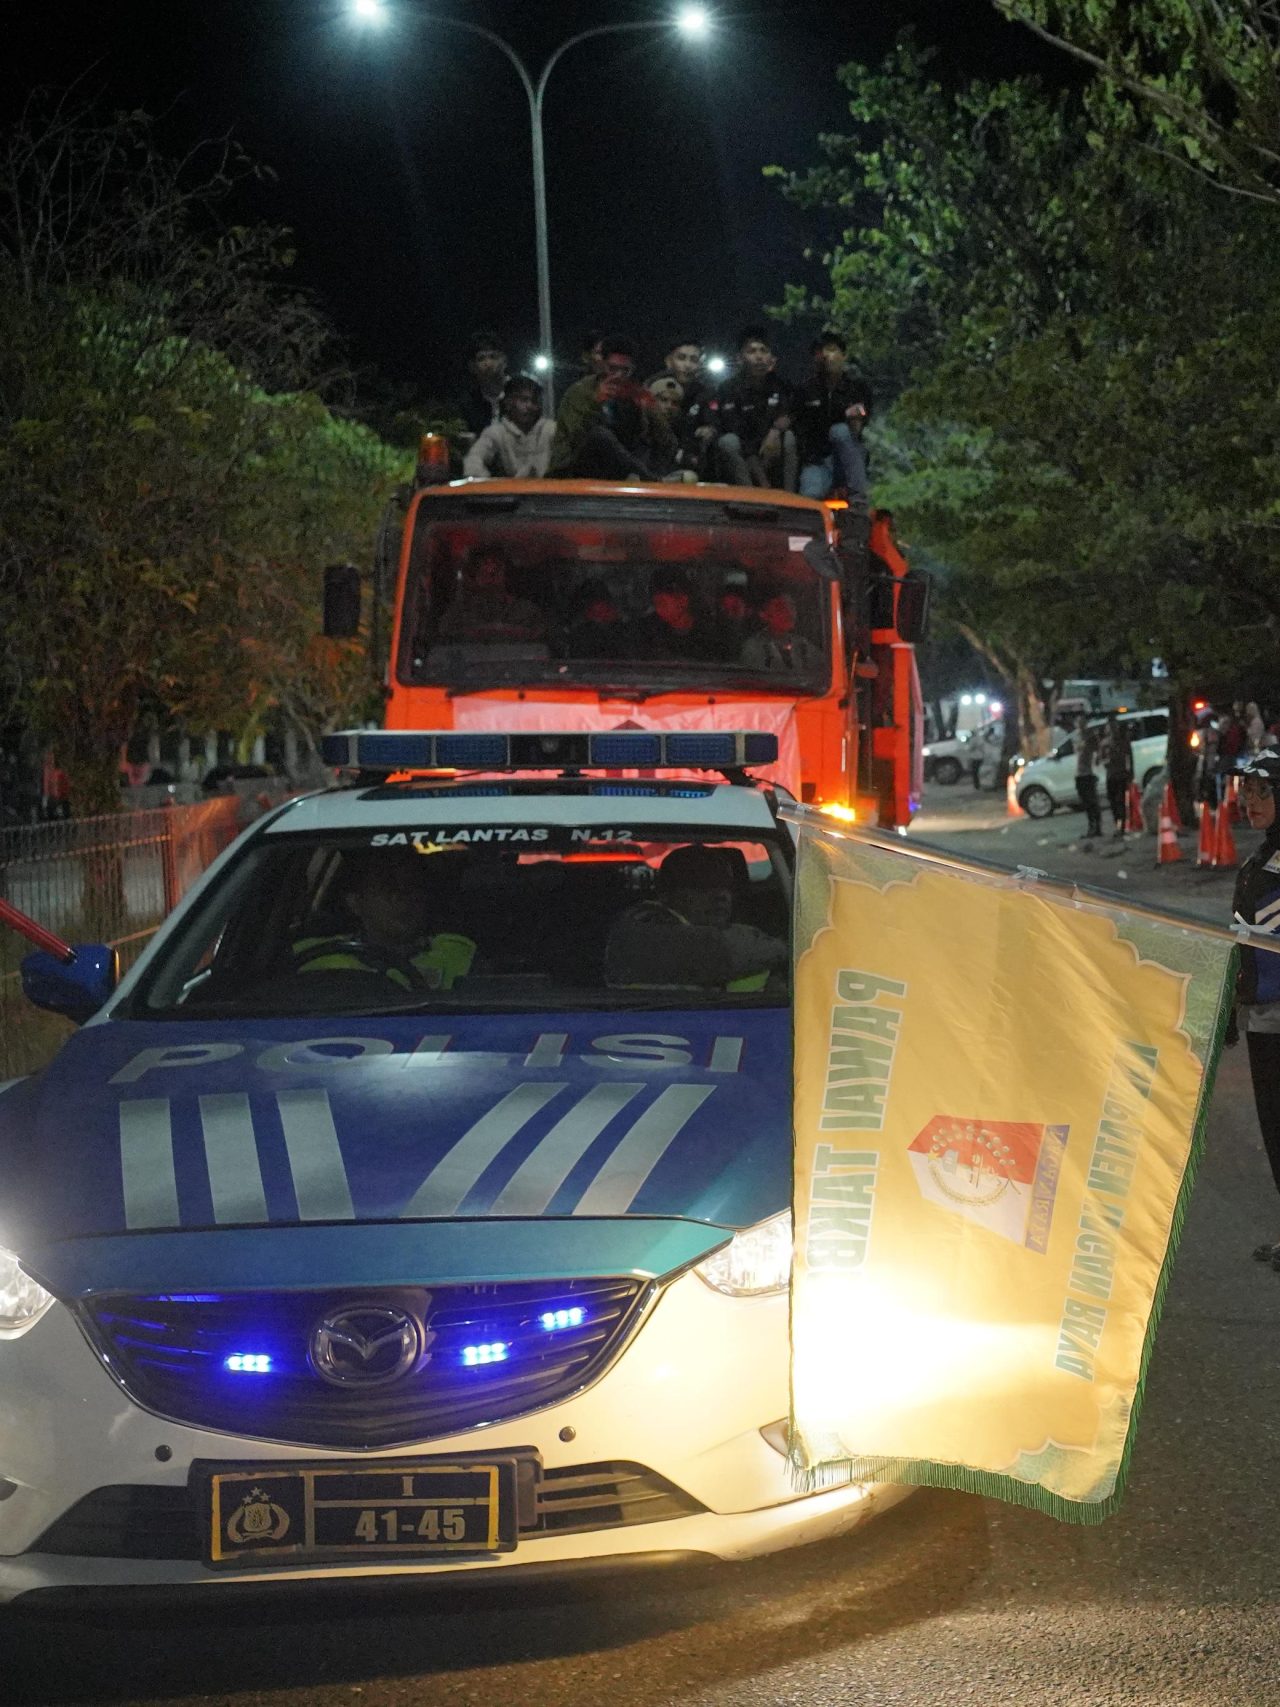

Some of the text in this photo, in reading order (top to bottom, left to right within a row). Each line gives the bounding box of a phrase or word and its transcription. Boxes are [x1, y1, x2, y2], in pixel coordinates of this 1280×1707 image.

[370, 828, 633, 847] SAT LANTAS N.12
[108, 1033, 747, 1084] POLISI
[401, 1475, 415, 1497] I
[354, 1508, 466, 1542] 41-45
